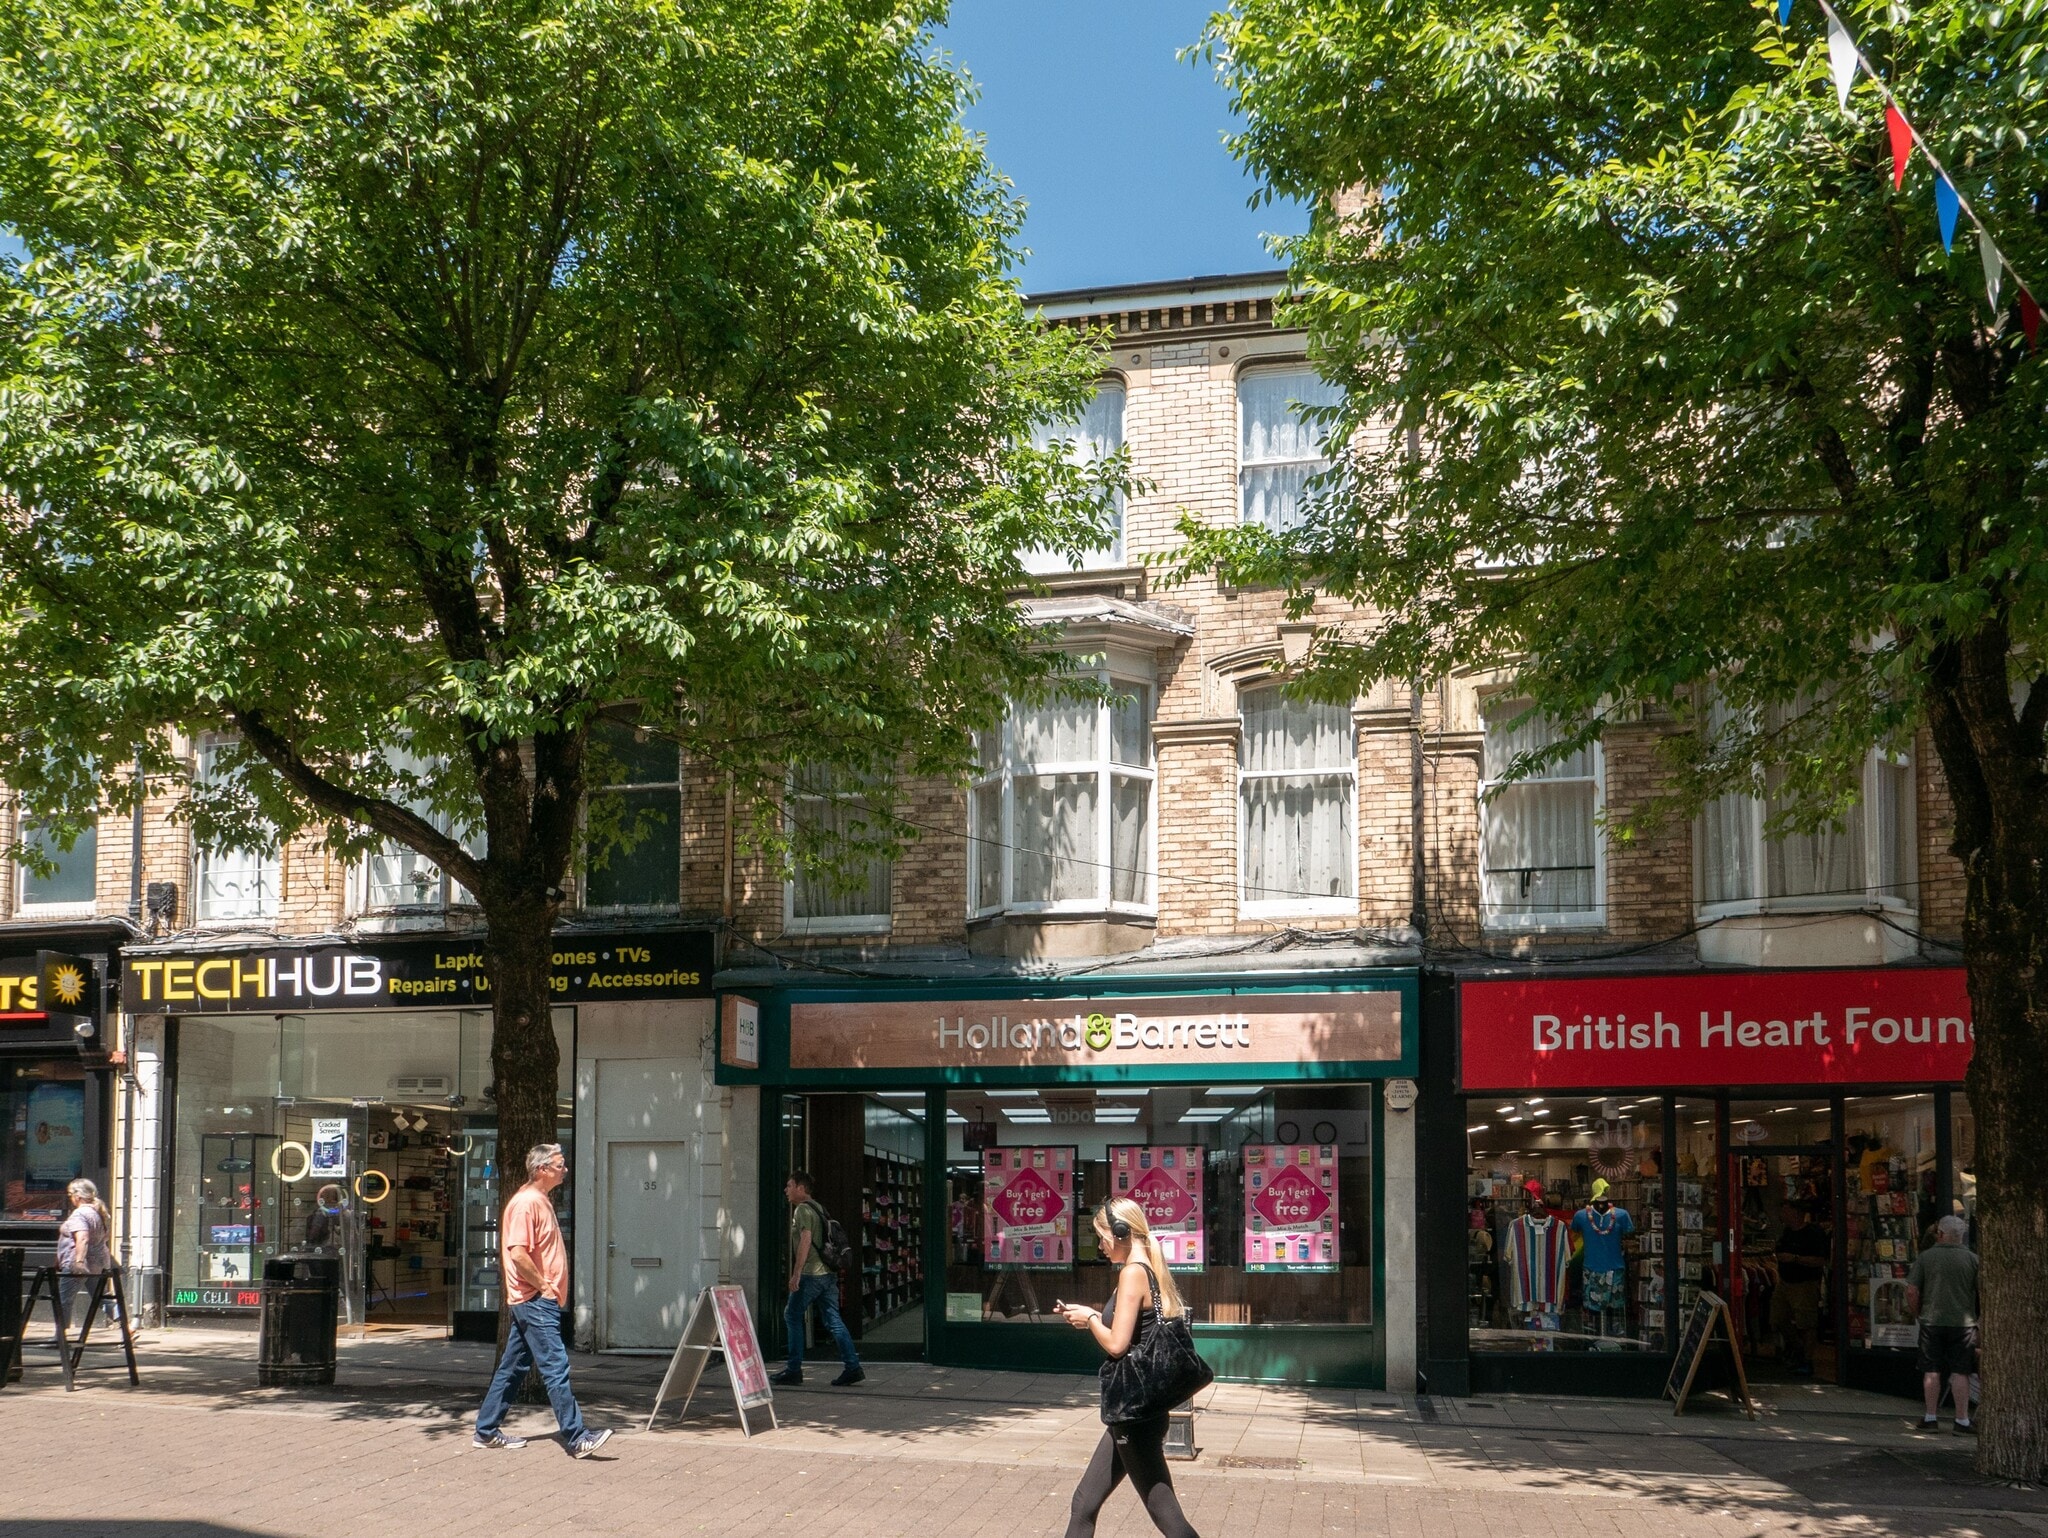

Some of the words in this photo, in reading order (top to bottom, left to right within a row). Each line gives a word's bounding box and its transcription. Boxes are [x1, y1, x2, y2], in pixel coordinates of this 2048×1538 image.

[435, 953, 484, 971] Lapto
[551, 951, 597, 966] ones
[615, 947, 651, 963] TVs
[131, 955, 382, 1000] TECHHUB
[388, 977, 457, 996] Repairs
[587, 969, 700, 988] Accessories
[939, 1014, 1081, 1050] Holland
[1115, 1012, 1250, 1048] Barrett
[1532, 1011, 1681, 1051] British
[1700, 1010, 1831, 1048] Heart
[1845, 1007, 1976, 1044] Foun
[644, 1181, 657, 1191] 35
[1268, 1187, 1285, 1198] Buy
[1288, 1187, 1292, 1196] 1
[1295, 1188, 1309, 1199] get
[1311, 1187, 1315, 1196] 1
[1006, 1189, 1023, 1199] Buy
[1024, 1189, 1029, 1198] 1
[1030, 1190, 1044, 1201] get
[1046, 1189, 1051, 1198] 1
[1134, 1188, 1151, 1199] Buy
[1153, 1189, 1158, 1198] 1
[1160, 1190, 1174, 1201] get
[1176, 1189, 1180, 1198] 1
[1012, 1201, 1044, 1217] free
[1142, 1201, 1174, 1217] free
[1275, 1200, 1309, 1216] free
[176, 1290, 198, 1304] AND
[203, 1290, 231, 1304] CELL
